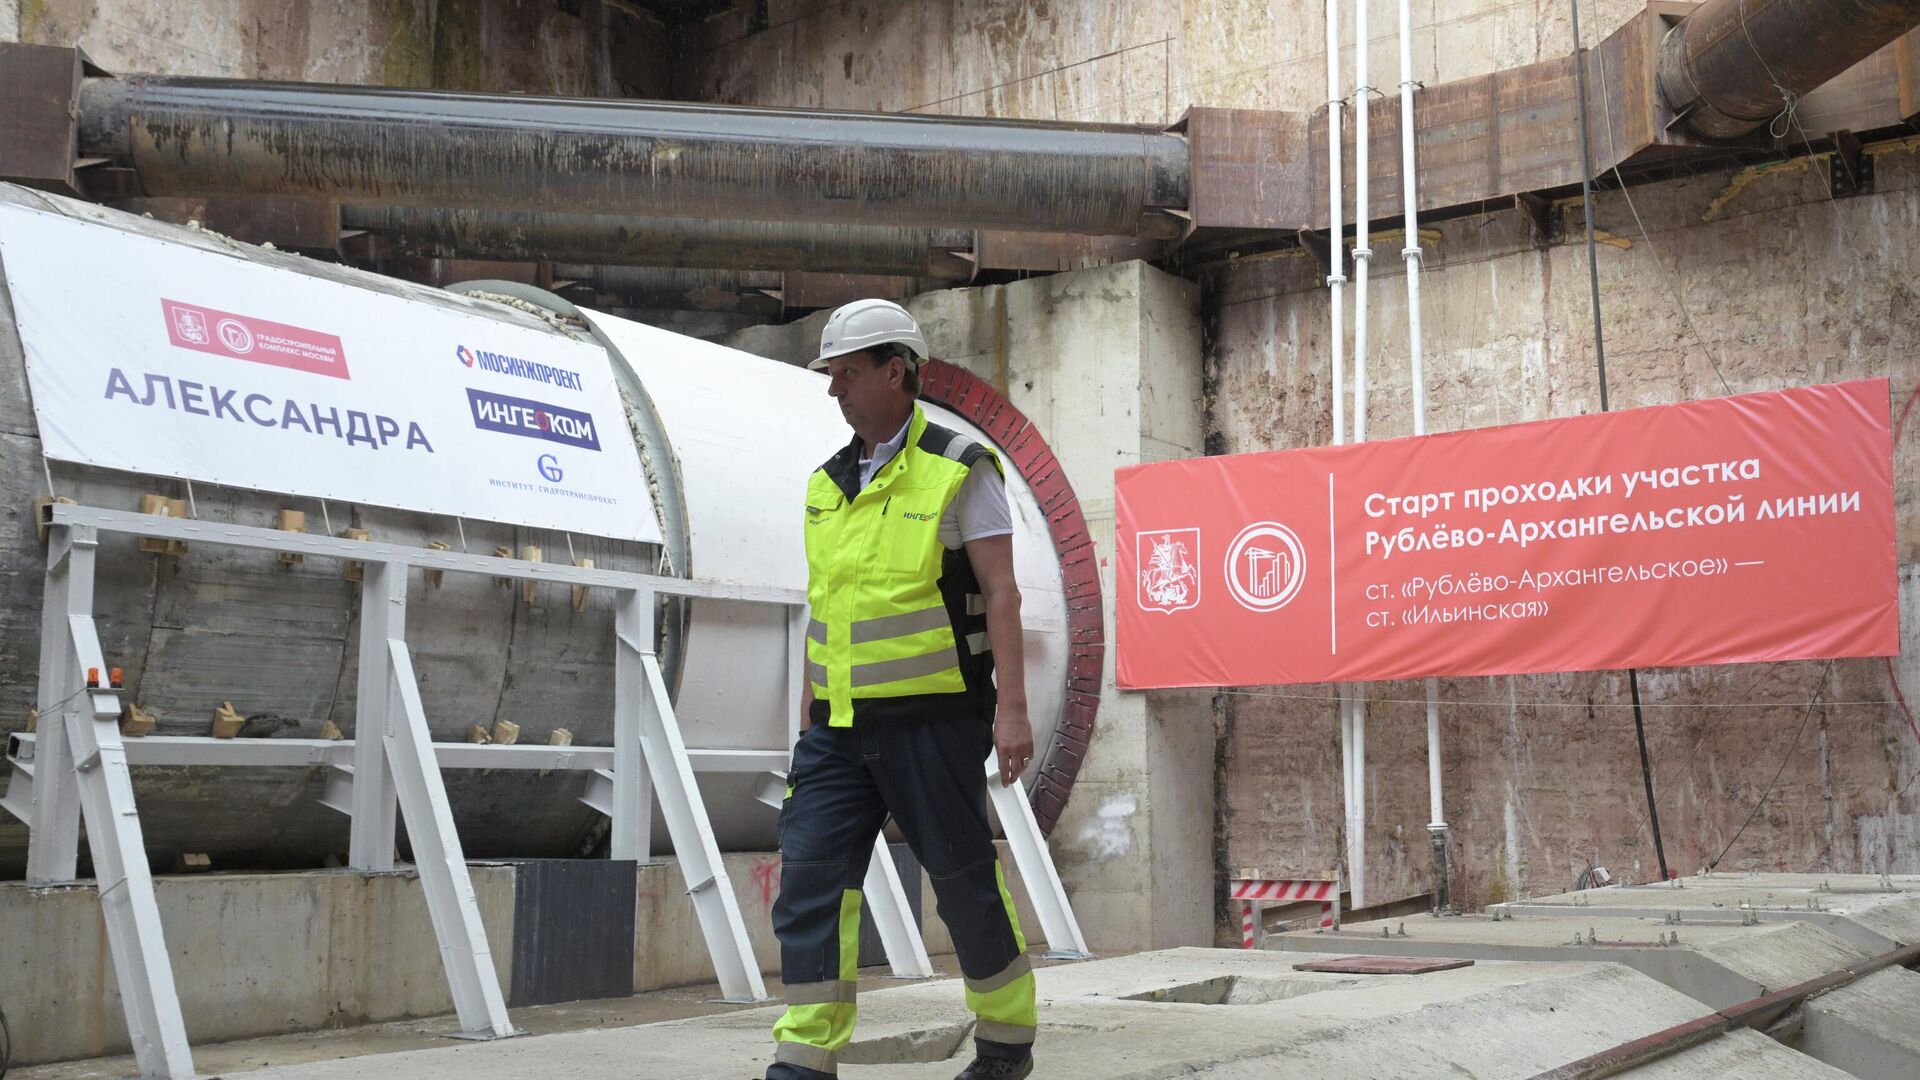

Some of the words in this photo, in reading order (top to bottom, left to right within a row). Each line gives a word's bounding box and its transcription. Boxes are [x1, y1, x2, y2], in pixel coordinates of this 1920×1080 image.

[256, 333, 336, 355] ГРАДОСТРОИТЕЛЬНЫЙ
[258, 342, 301, 356] КОМПЛЕКС
[302, 350, 335, 363] МОСКВЫ
[476, 350, 583, 392] МОСИНЖПРОЕКТ
[104, 367, 434, 453] АЛЕКСАНДРА
[477, 399, 593, 441] ИНГЕОКОМ
[489, 478, 534, 492] ИНСТИТУТ
[538, 485, 617, 505] ГИДРОТРАНСПРОЕКТ
[1364, 491, 1455, 519] Старт
[1464, 474, 1612, 513] проходки
[1621, 458, 1760, 498] участка
[1365, 494, 1745, 560] Рублёво-Архангельской
[1756, 491, 1860, 521] линии
[1366, 583, 1395, 600] ст.
[1401, 557, 1728, 601] «Рублёво-Архангельское»
[1366, 610, 1395, 628] ст.
[1402, 600, 1549, 625] «Ильинская»
